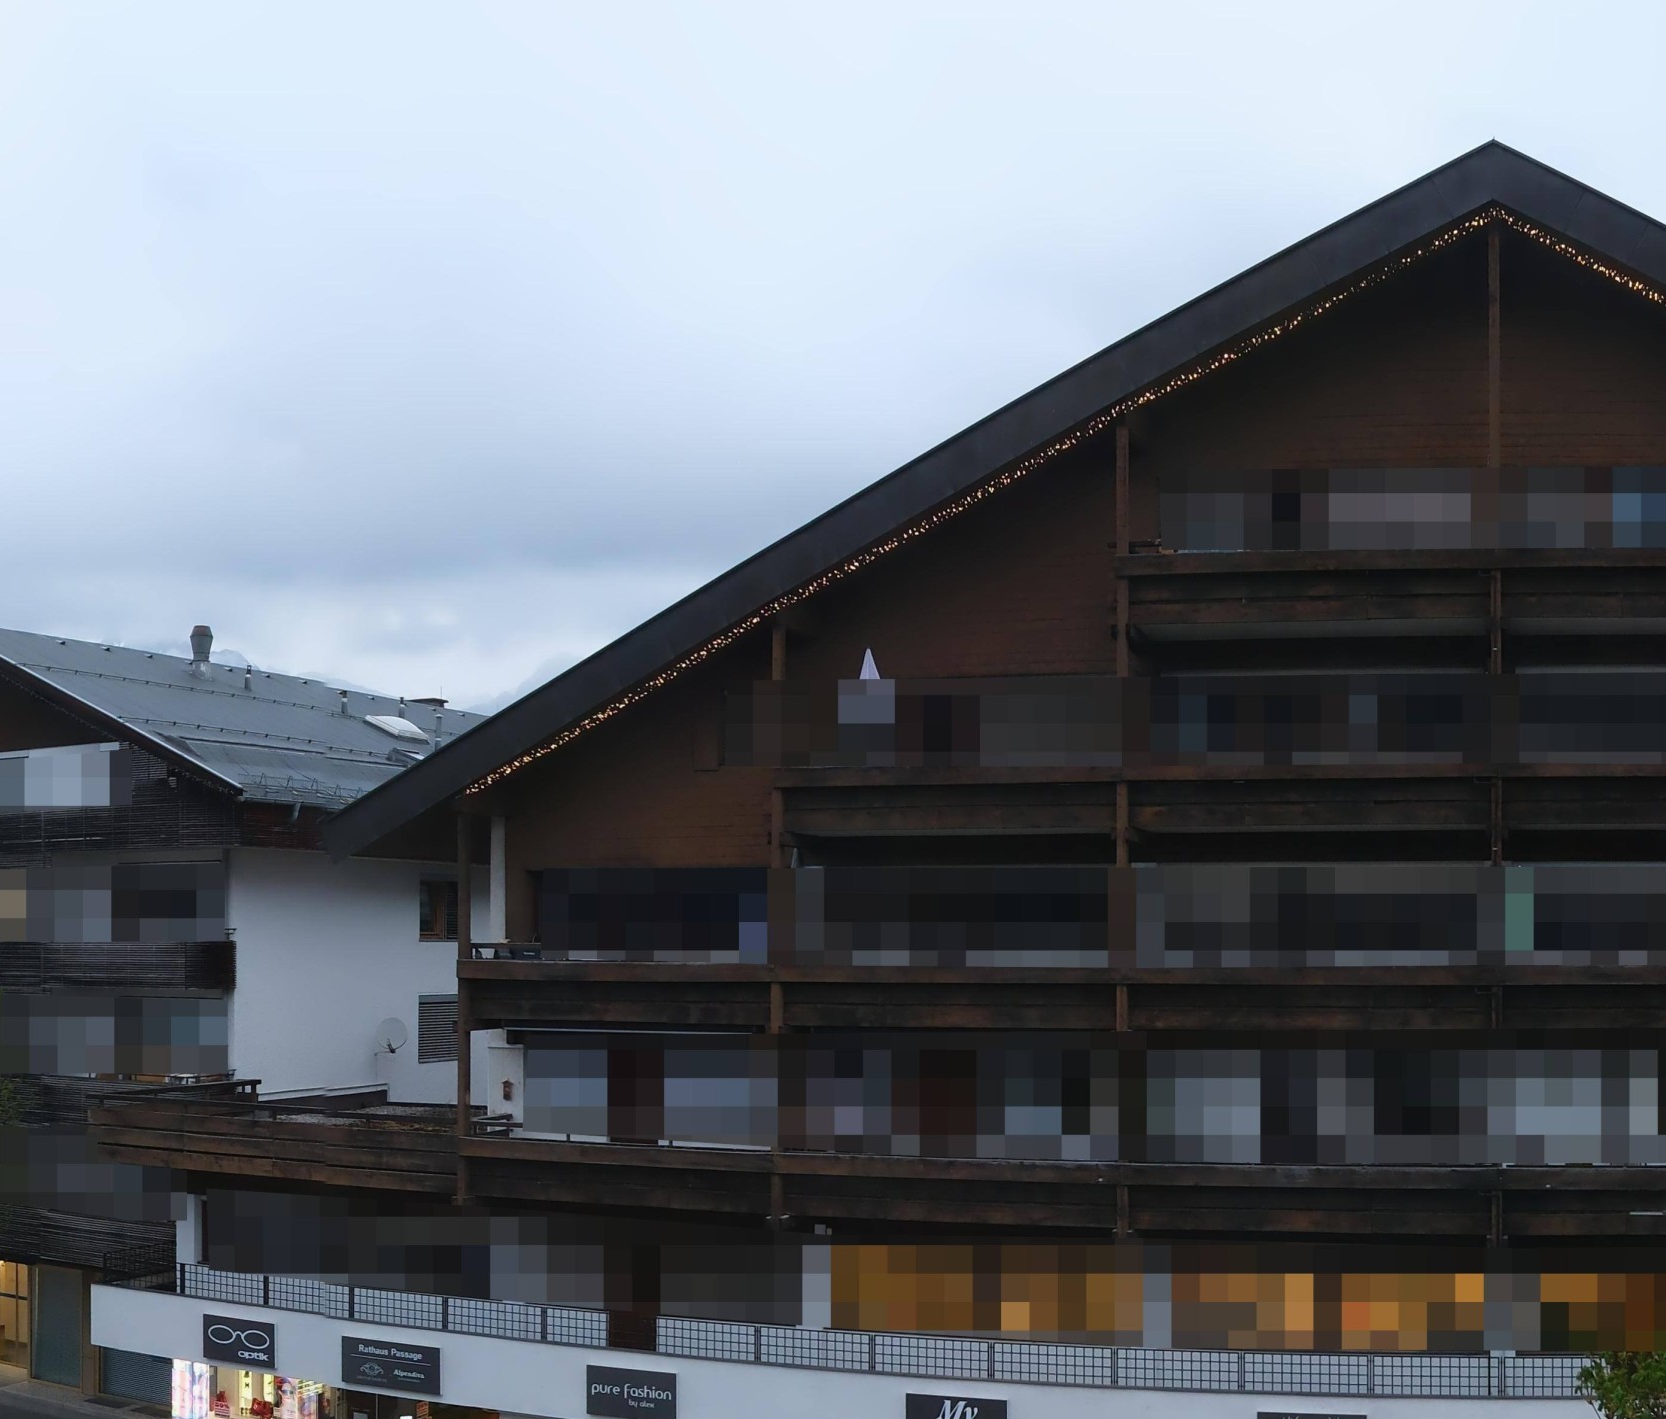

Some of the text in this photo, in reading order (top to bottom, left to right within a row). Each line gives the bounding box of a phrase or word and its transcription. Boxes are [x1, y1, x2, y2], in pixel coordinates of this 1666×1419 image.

[238, 1350, 270, 1362] optik
[358, 1344, 423, 1361] Rathaus Passage
[591, 1382, 672, 1400] pure fashion
[628, 1399, 638, 1408] by
